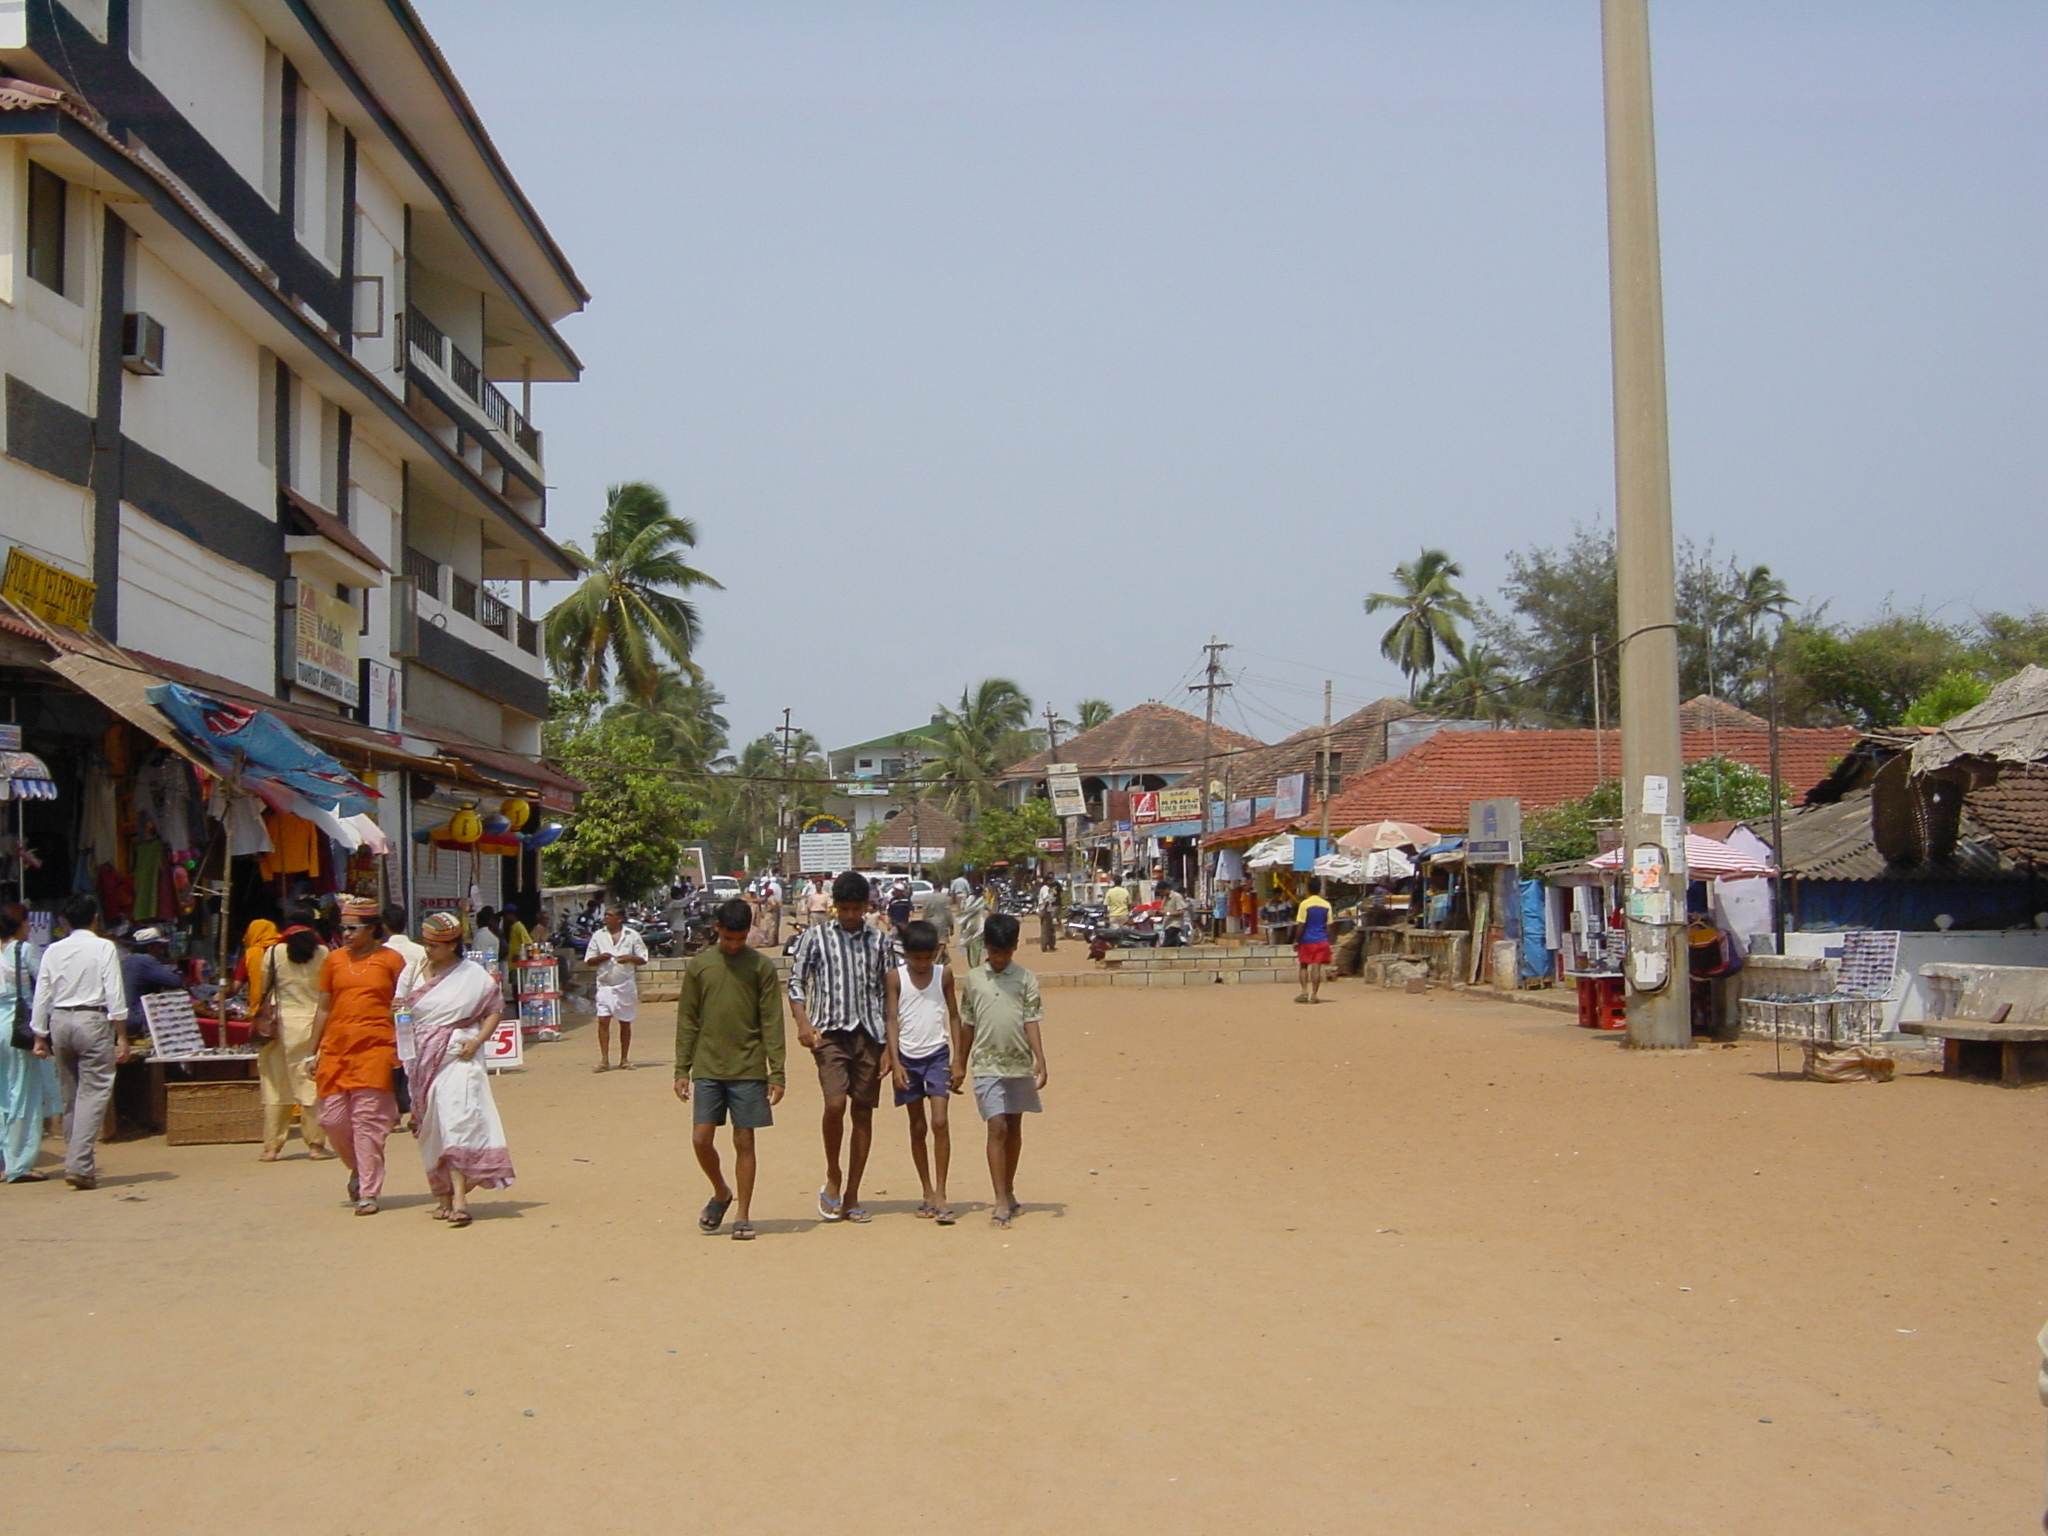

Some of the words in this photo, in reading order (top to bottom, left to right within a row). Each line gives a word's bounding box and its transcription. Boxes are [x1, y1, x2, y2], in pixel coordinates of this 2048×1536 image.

[6, 552, 43, 600] PUBLIC
[41, 566, 95, 621] TELEPHONE
[317, 613, 343, 650] Kodak
[306, 639, 324, 664] FILM
[298, 662, 320, 686] TOURIST
[495, 1030, 514, 1055] 5
